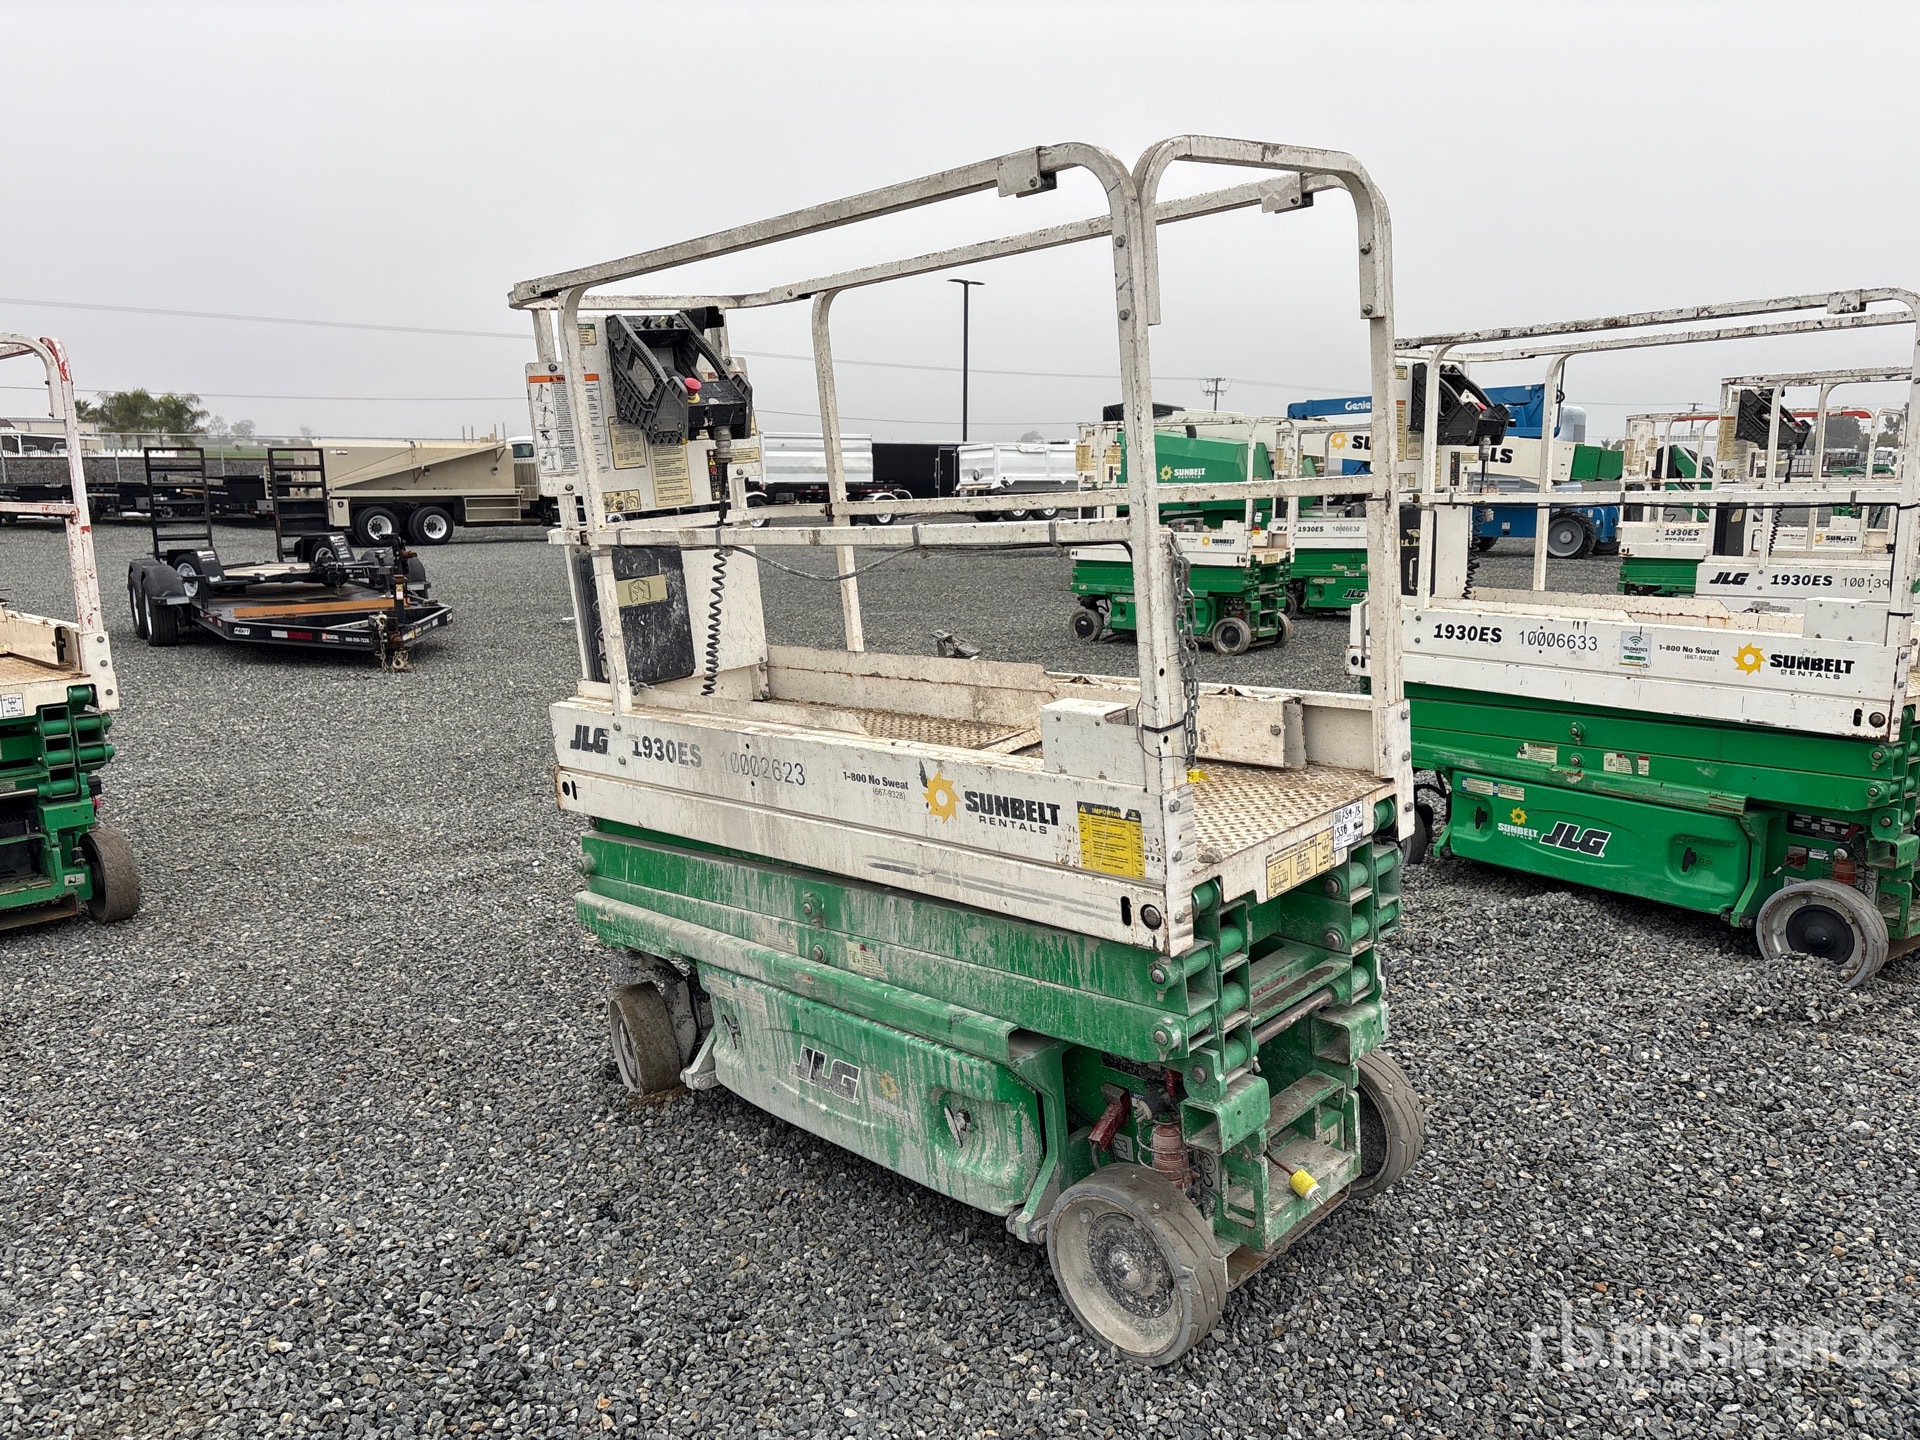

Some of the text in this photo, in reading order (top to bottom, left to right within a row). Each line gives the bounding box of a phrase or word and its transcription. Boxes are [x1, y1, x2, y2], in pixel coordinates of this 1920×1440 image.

[1344, 400, 1371, 411] Genie
[1173, 467, 1206, 476] SUNBELT
[1664, 528, 1700, 536] 1930ES
[1709, 571, 1890, 589] JLG 1930ES 100139
[1433, 623, 1598, 652] 1930ES 10006633
[1658, 644, 1720, 656] 1-800 No Sweat
[1684, 654, 1716, 662] (667-9328)
[1769, 652, 1855, 675] SUNBELT
[1780, 668, 1842, 680] RENTALS
[569, 724, 807, 786] JLG 1930ES 10002623
[843, 771, 909, 790] 1-800 No Sweat
[872, 787, 906, 801] (667-9328)
[963, 790, 1061, 827] SUNBELT
[1091, 807, 1121, 818] IMPORTAN
[978, 815, 1048, 835] RENTALS
[1497, 822, 1539, 838] SUNBELT
[1502, 831, 1533, 841] RENTALS
[1539, 821, 1612, 857] JLG
[788, 1044, 862, 1104] JLG
